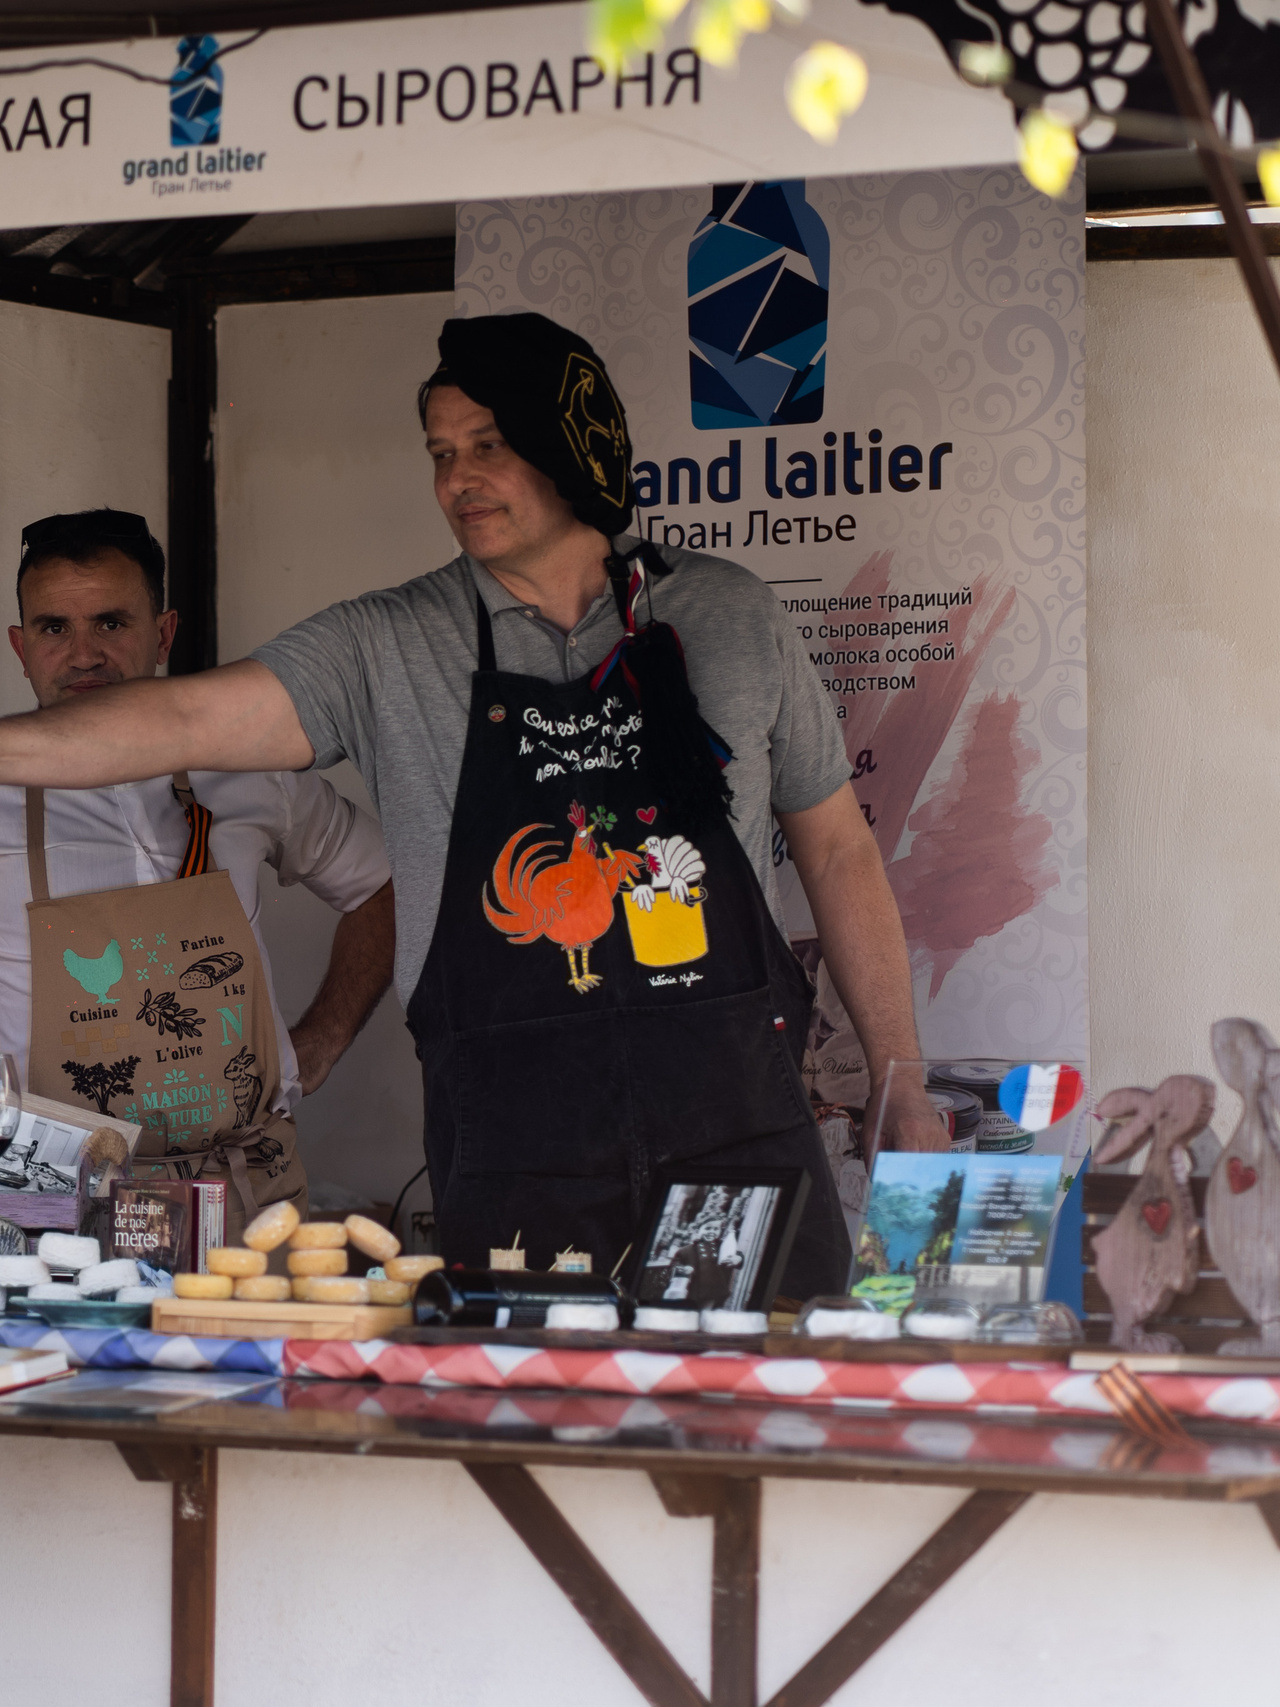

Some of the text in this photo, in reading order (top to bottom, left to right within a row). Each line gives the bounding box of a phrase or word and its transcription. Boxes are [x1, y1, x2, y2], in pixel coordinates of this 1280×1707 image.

[293, 46, 701, 132] СЫРОВАРНЯ
[123, 147, 267, 185] grand laitier
[152, 177, 232, 198] Гран Летье
[632, 428, 953, 508] and laitier
[647, 509, 857, 550] Гран Летье
[877, 586, 972, 613] традиций
[818, 620, 949, 642] сыроварения
[809, 643, 955, 666] молока особой
[821, 676, 916, 695] водством
[180, 935, 225, 952] Farine
[223, 983, 246, 997] 1 kg
[69, 1006, 119, 1024] Cuisine
[216, 1003, 244, 1046] N
[156, 1045, 203, 1063] L'olive
[141, 1083, 211, 1110] MAISON
[145, 1105, 213, 1129] NATURE
[114, 1200, 164, 1215] La cuisine
[114, 1214, 148, 1229] de nos
[114, 1228, 159, 1248] mères
